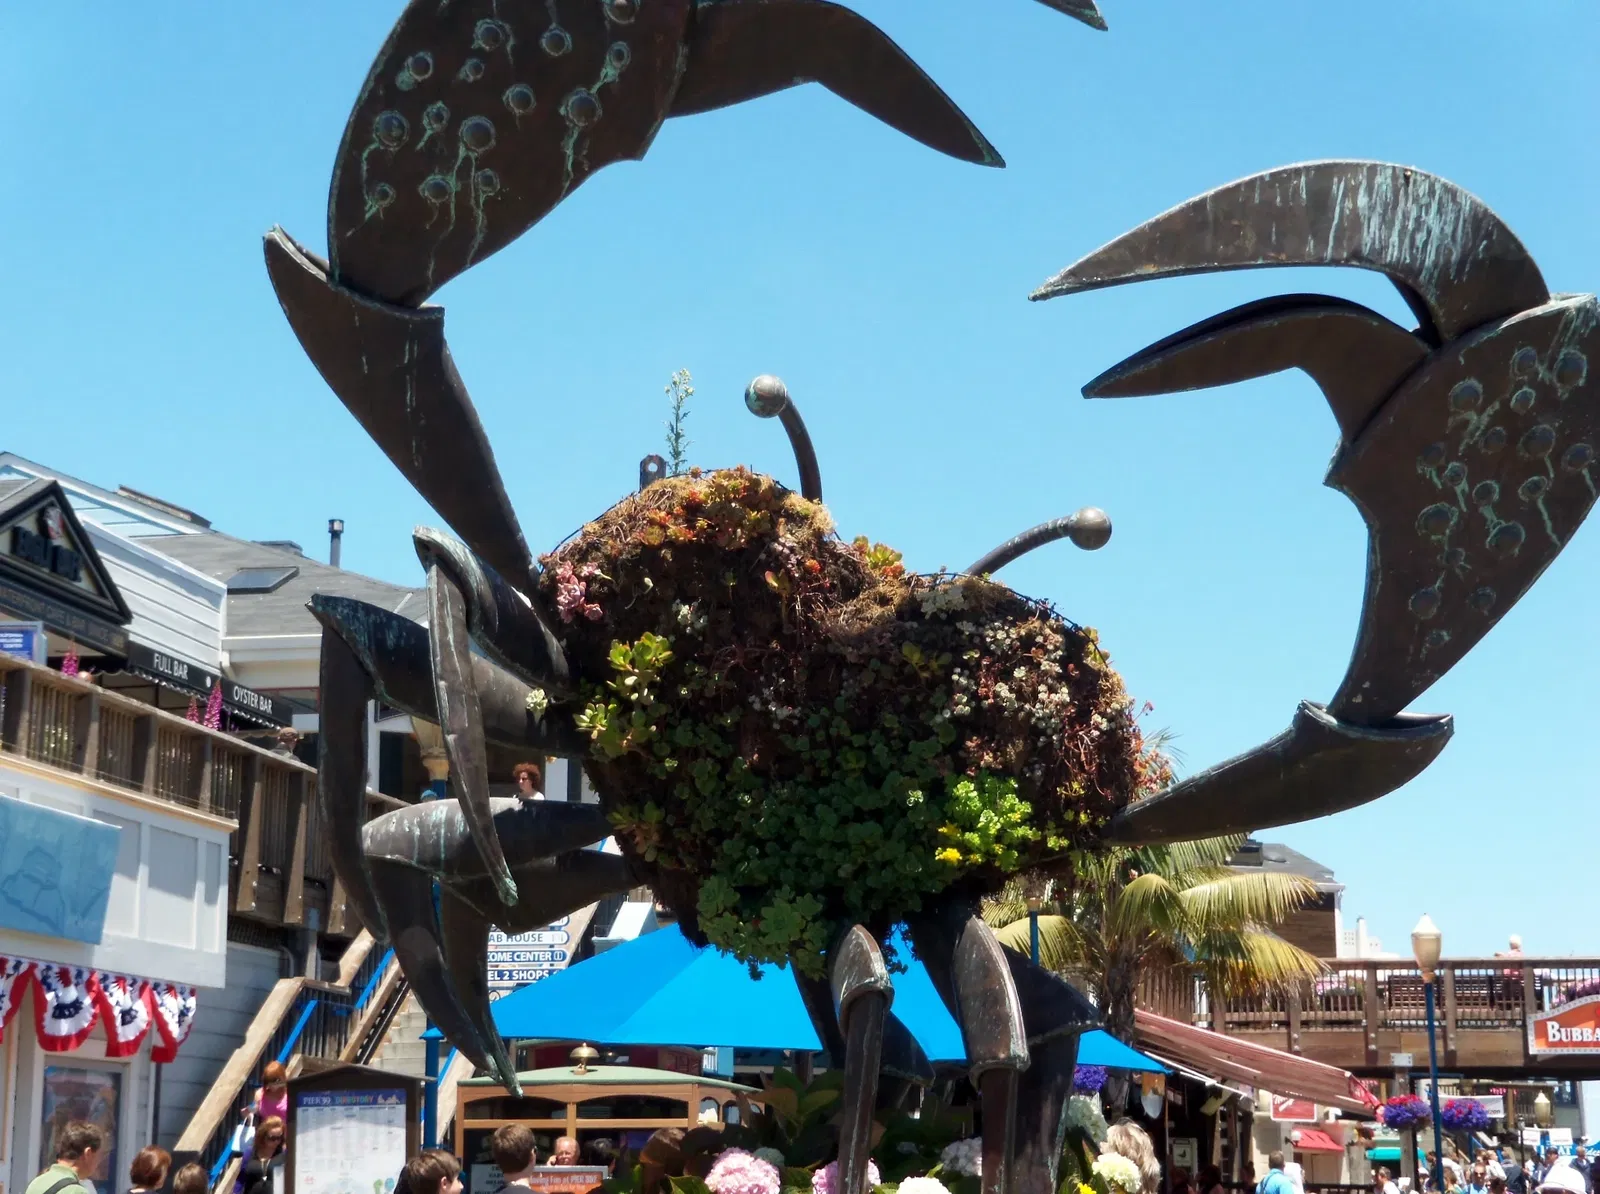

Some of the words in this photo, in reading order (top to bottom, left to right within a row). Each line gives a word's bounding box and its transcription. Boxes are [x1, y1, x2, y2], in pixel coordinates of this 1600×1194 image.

[153, 653, 172, 674] FULL
[173, 660, 188, 680] BAR
[233, 685, 258, 709] OYSTER
[259, 697, 273, 714] BAR
[489, 933, 503, 943] AB
[507, 933, 543, 943] HOUSE
[514, 951, 552, 962] CENTER
[488, 970, 501, 980] EL
[502, 970, 510, 980] 2
[512, 970, 549, 980] SHOPS
[1546, 1020, 1600, 1042] BUBBA
